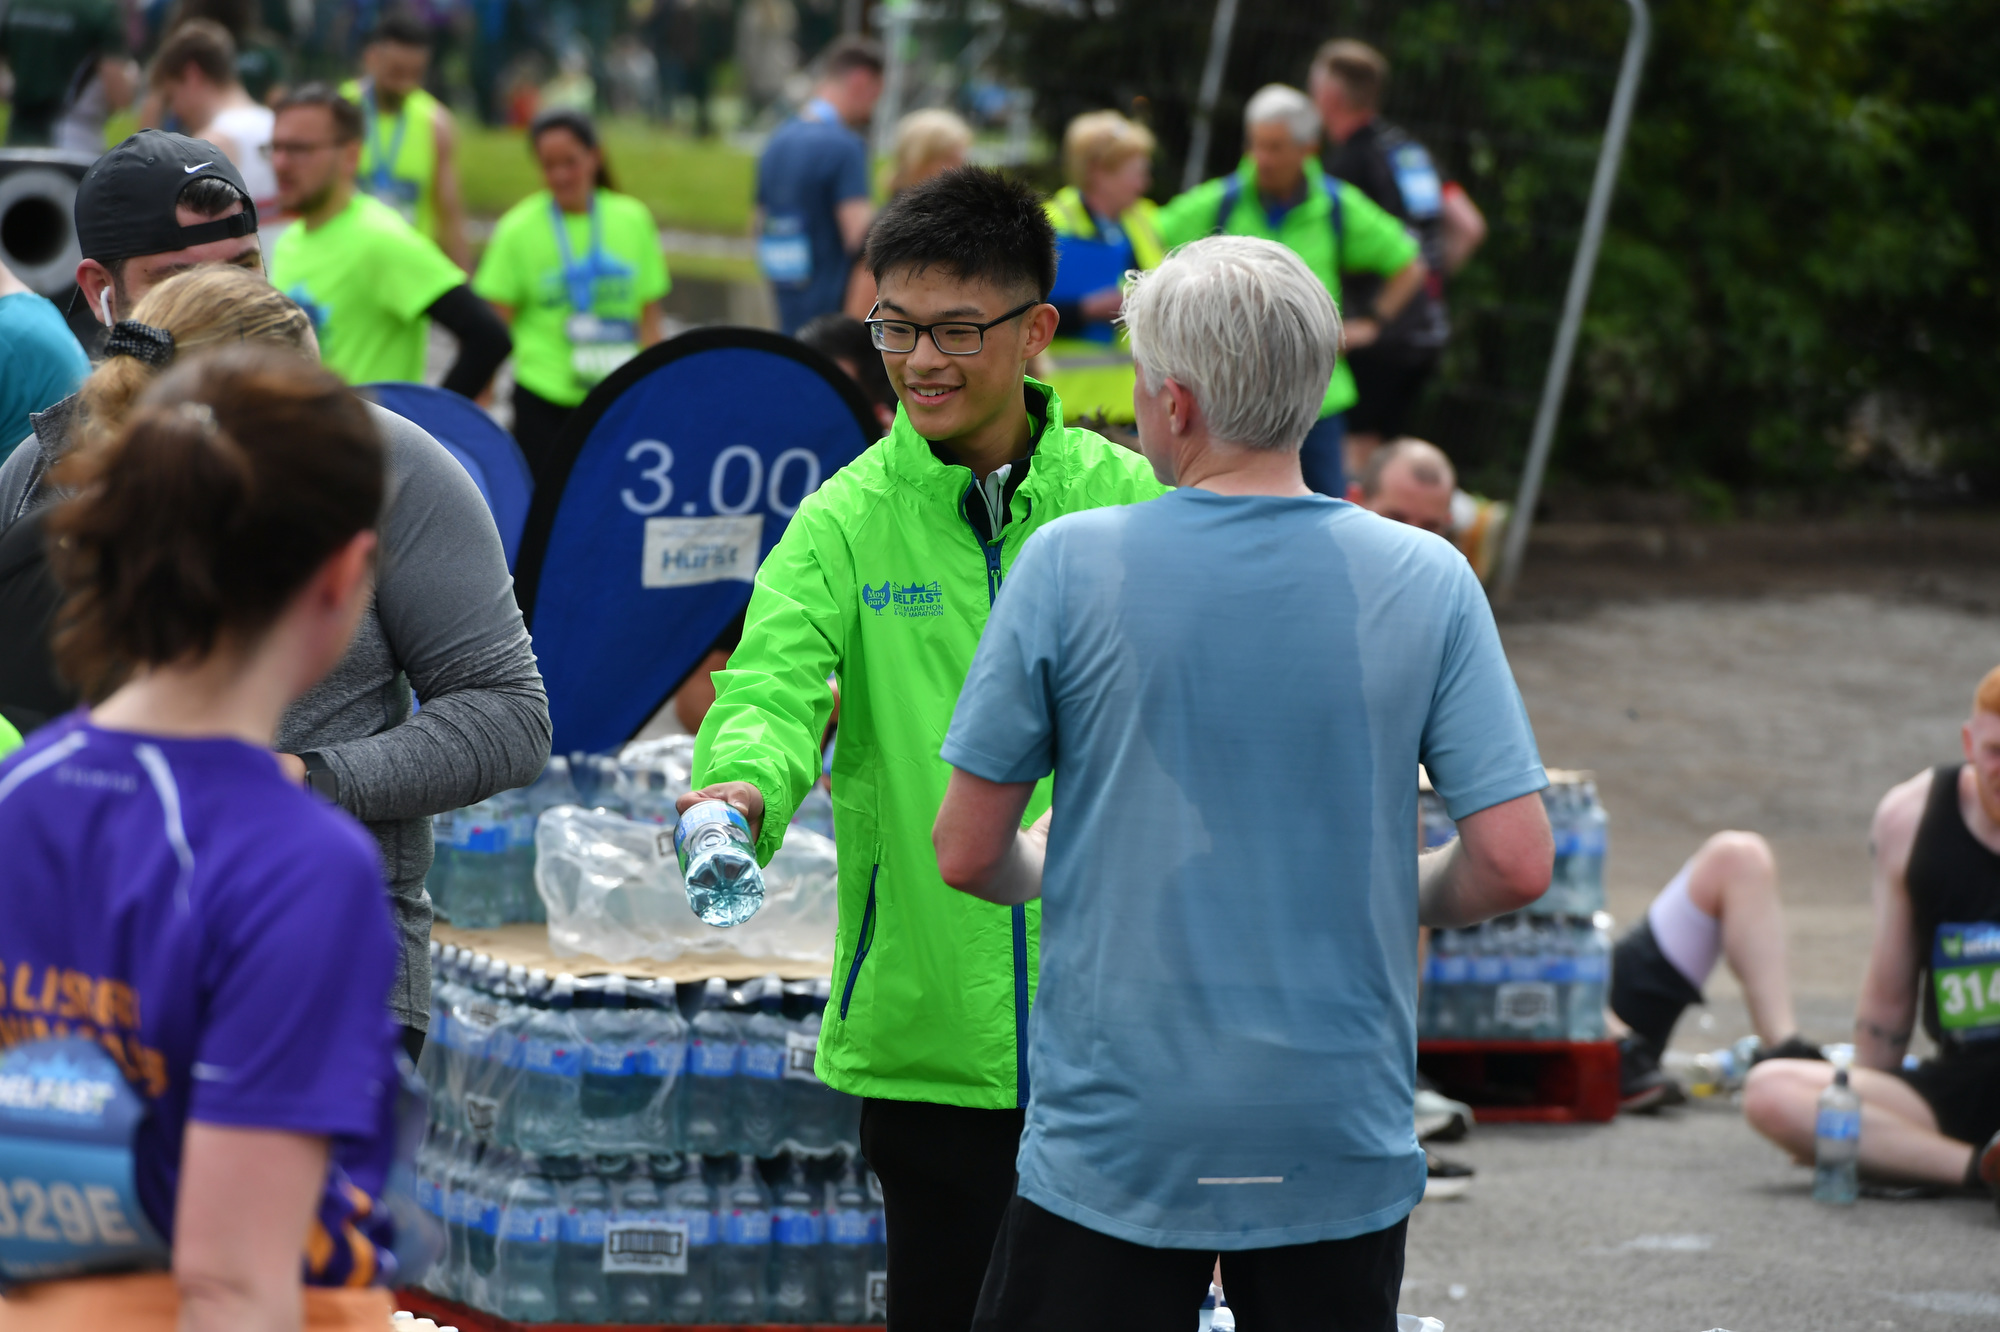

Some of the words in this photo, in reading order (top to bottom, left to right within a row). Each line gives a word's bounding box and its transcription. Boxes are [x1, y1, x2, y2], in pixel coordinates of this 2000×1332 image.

[620, 439, 821, 520] 3.00
[867, 590, 886, 599] Moy
[893, 593, 942, 604] BELFAST
[867, 599, 887, 608] park
[904, 604, 944, 612] MARATHON
[908, 610, 944, 618] MARATHON
